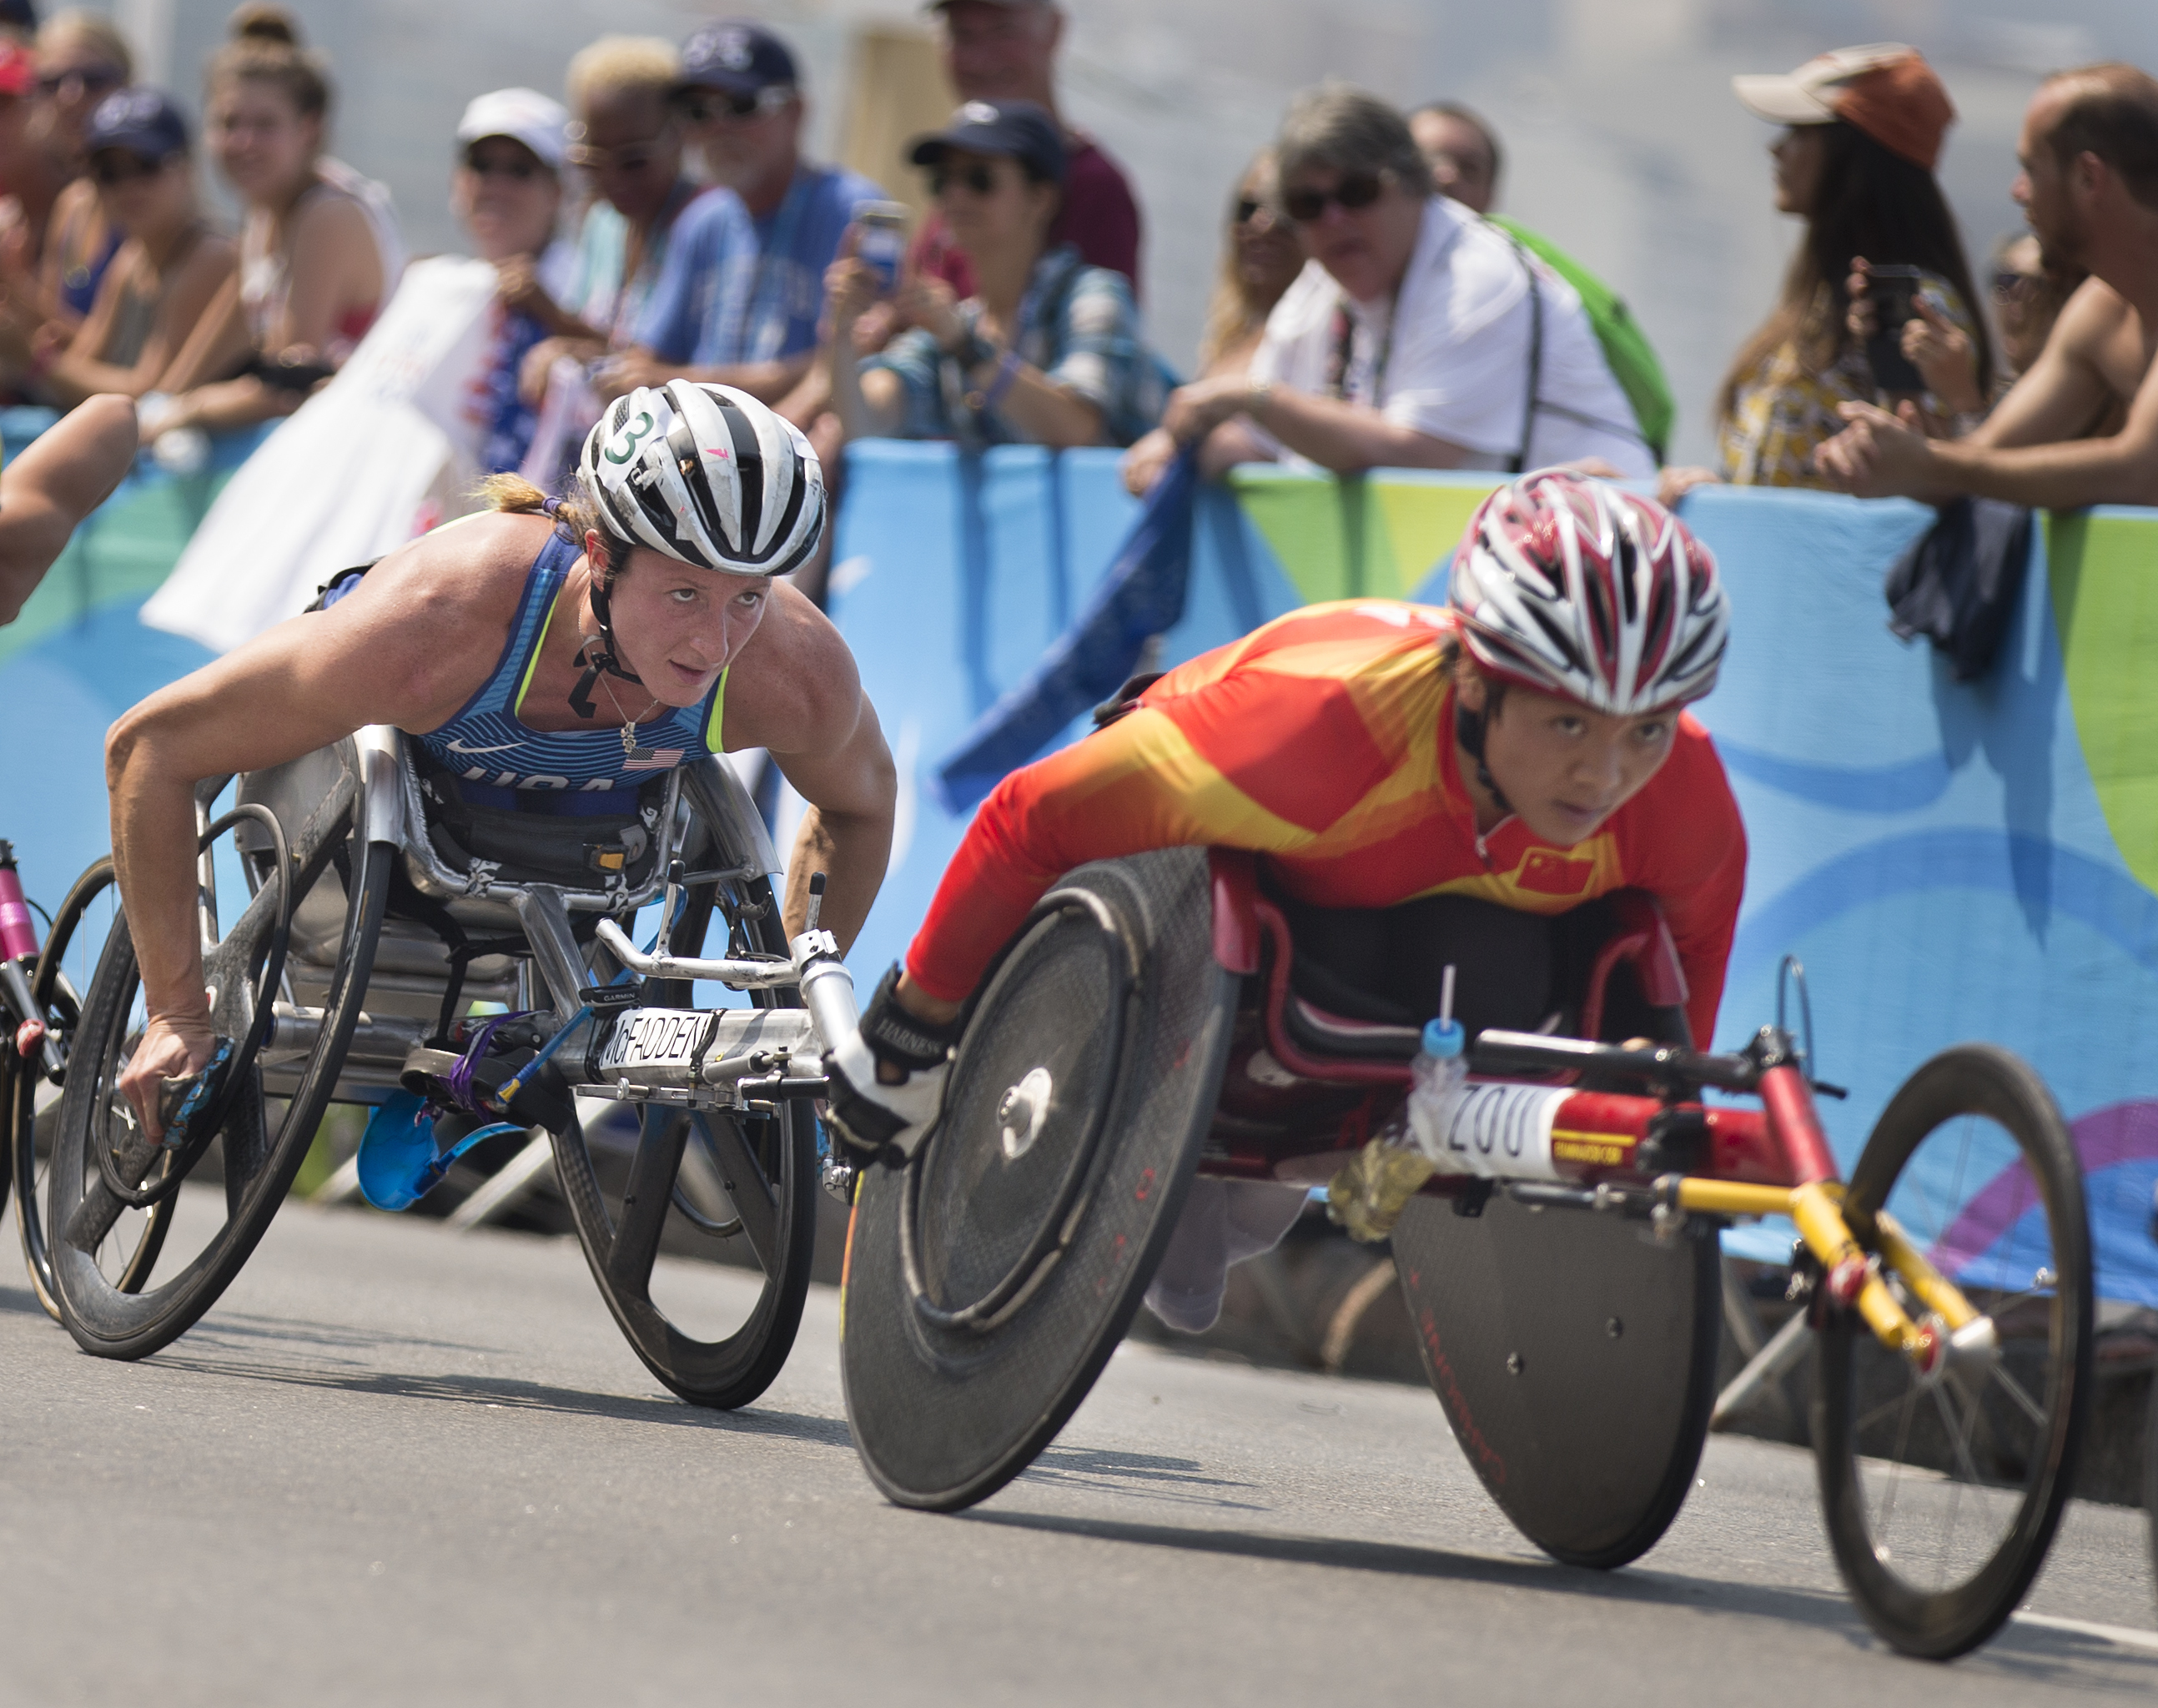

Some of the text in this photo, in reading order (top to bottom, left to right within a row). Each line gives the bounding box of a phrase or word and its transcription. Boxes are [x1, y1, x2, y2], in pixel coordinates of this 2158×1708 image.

[604, 411, 655, 465] 3
[603, 992, 636, 1002] GARMIN
[600, 1016, 712, 1067] McFADDEN
[1448, 1084, 1541, 1157] ZOU
